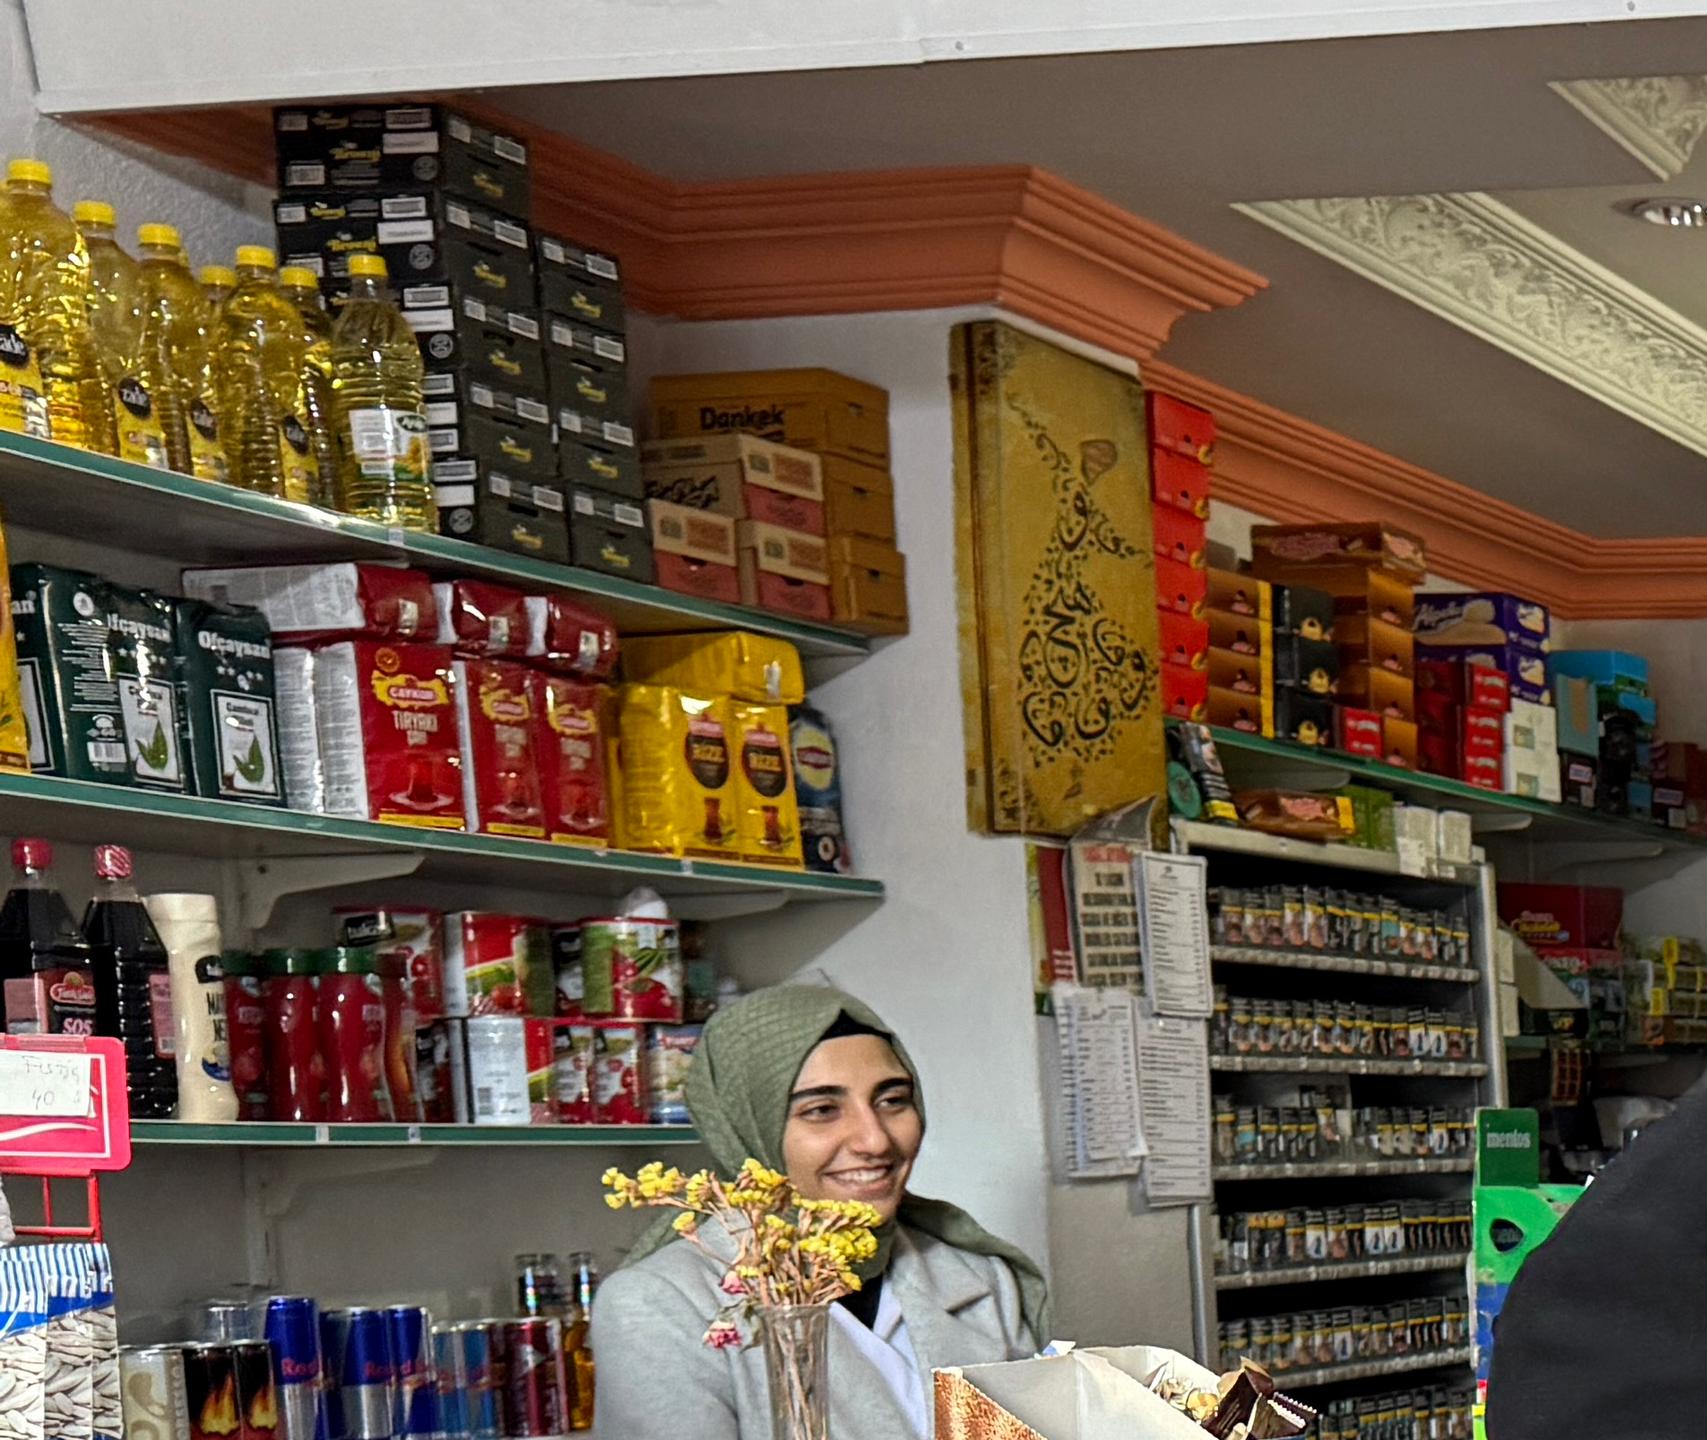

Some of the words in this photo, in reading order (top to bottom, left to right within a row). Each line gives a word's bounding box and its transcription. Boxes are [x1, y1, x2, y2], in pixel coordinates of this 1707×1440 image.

[701, 404, 785, 431] Dankek
[63, 1017, 93, 1035] SOS
[1486, 1128, 1531, 1149] mentos
